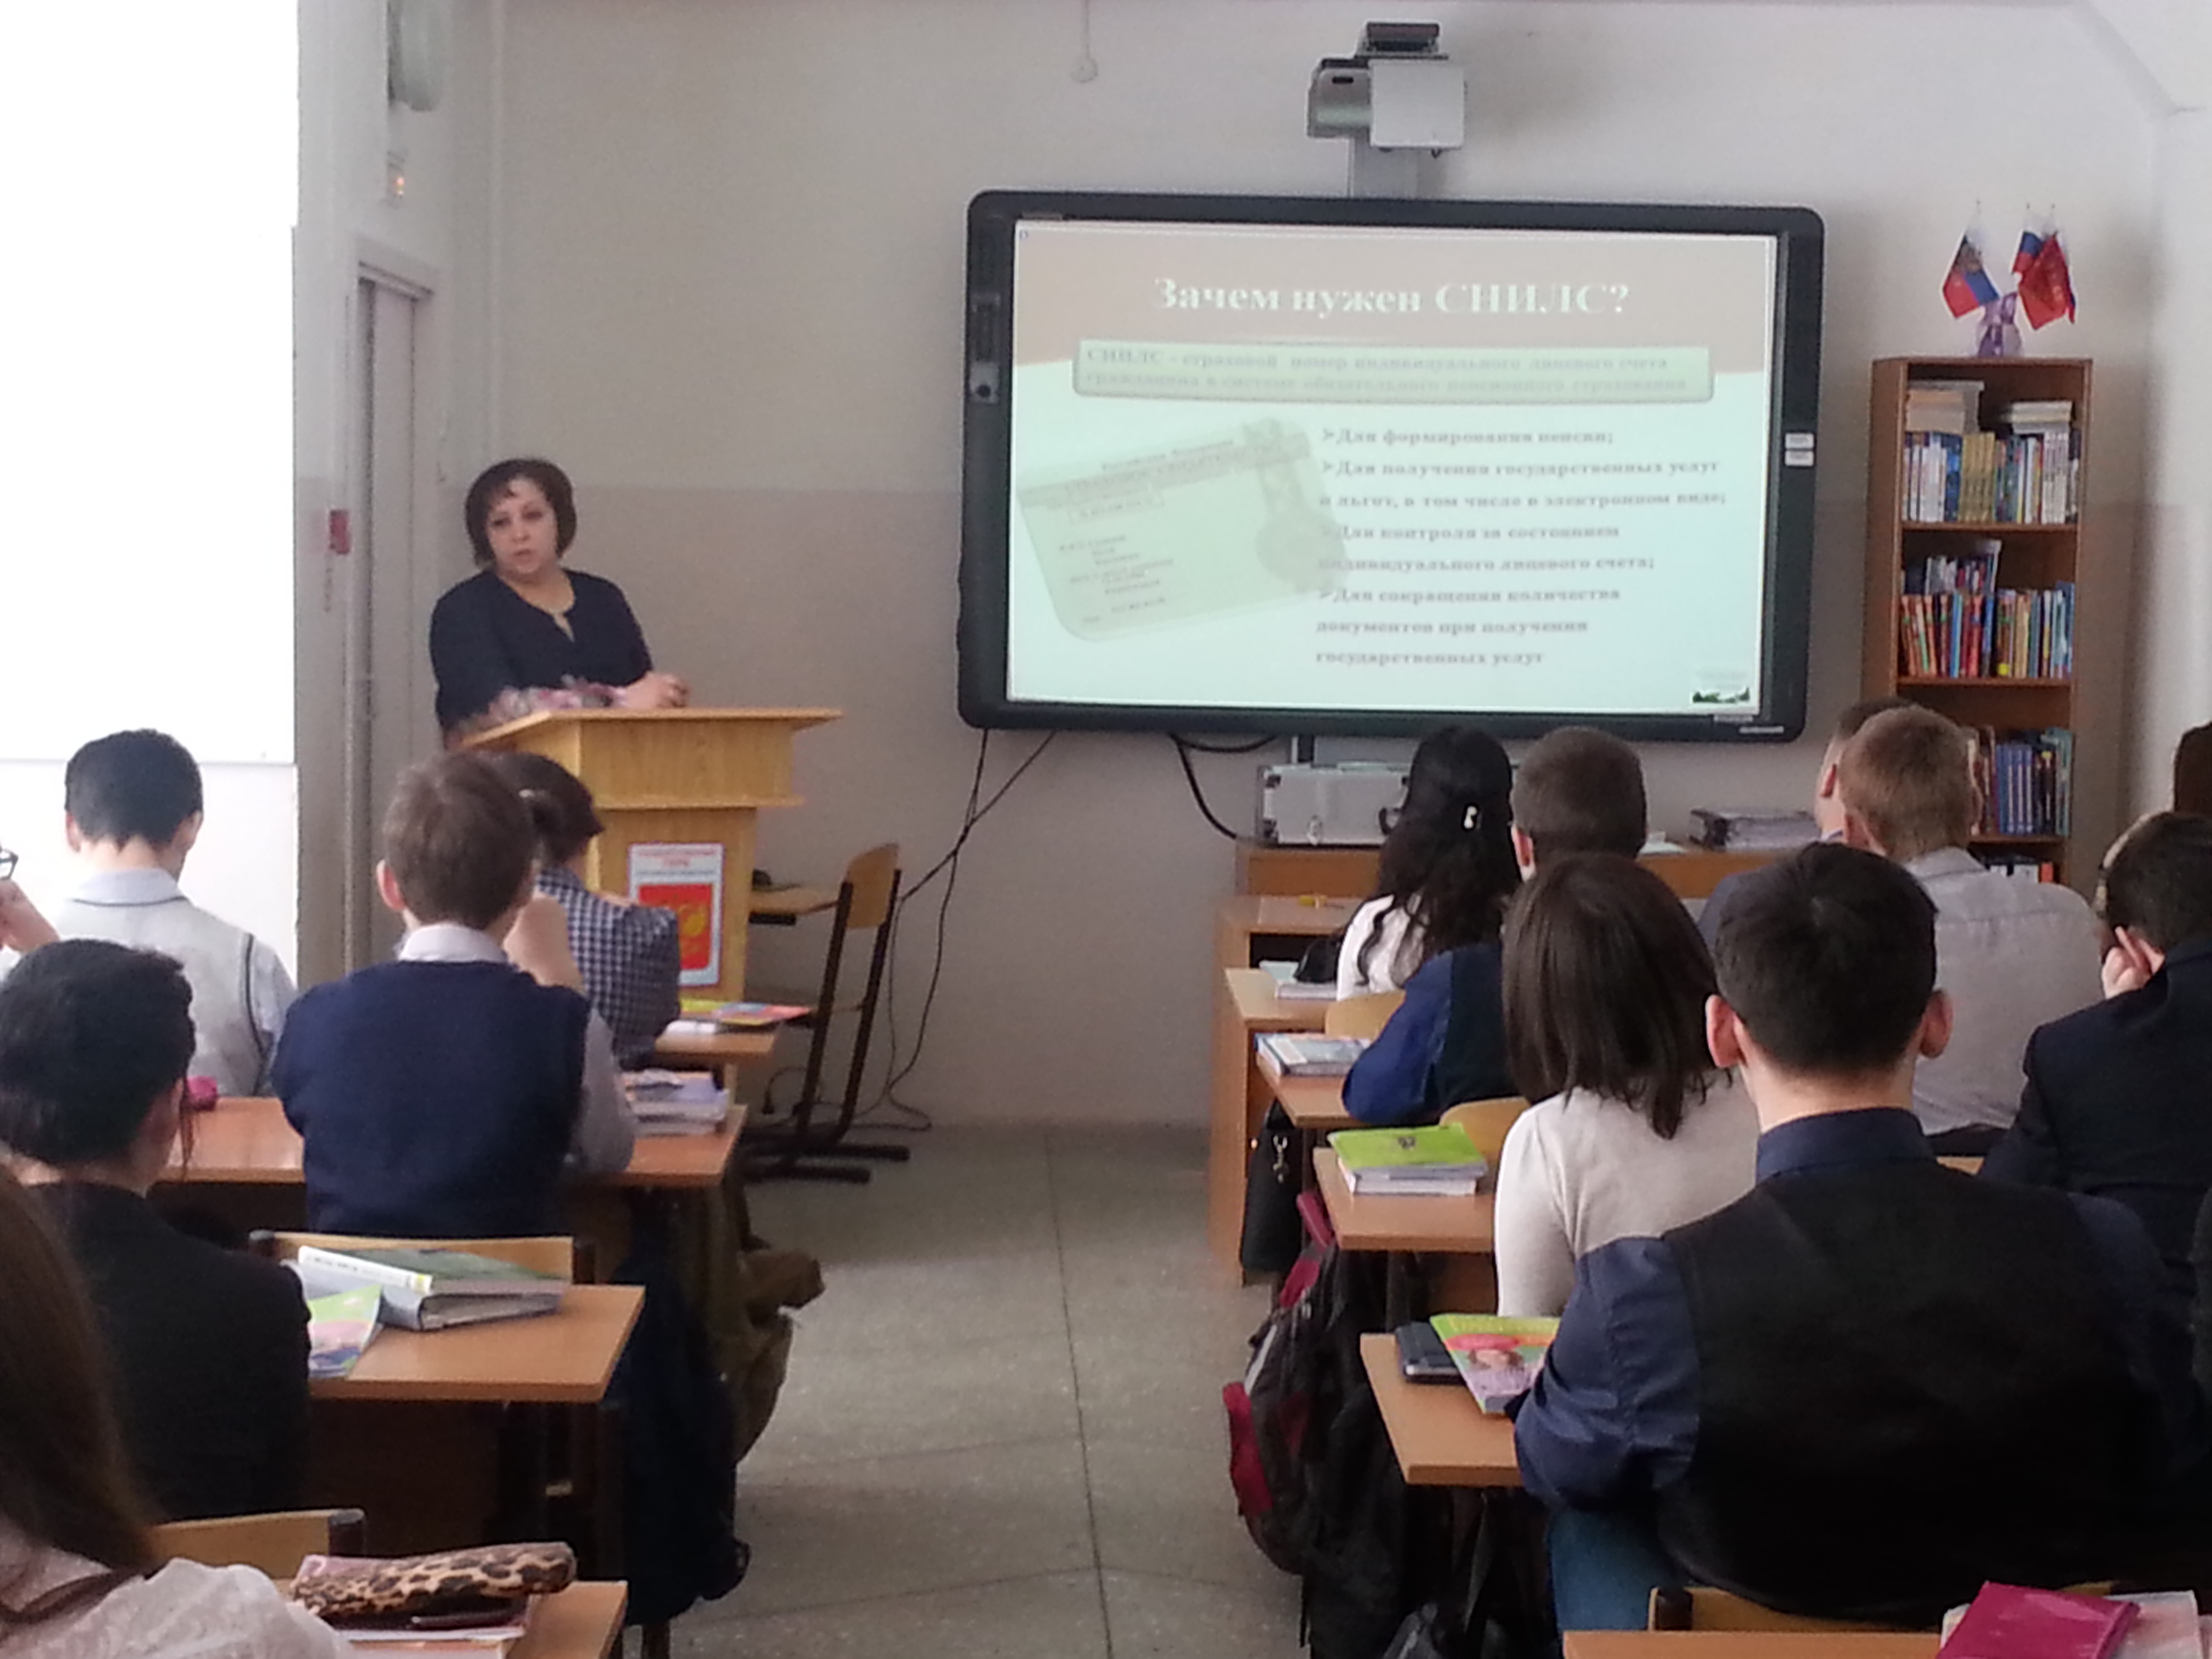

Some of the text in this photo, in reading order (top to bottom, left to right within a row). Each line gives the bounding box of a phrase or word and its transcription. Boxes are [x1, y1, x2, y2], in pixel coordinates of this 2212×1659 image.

[1153, 276, 1631, 319] Зачем нужен СНИЛС?
[1087, 348, 1164, 364] СНИЛС
[1336, 428, 1613, 447] Для формирования пенсии;
[1335, 460, 1721, 479] Для получения государственных услуг
[1338, 497, 1398, 509] льгот,
[1404, 497, 1415, 506] в
[1424, 497, 1458, 506] том
[1464, 496, 1521, 506] числе
[1527, 496, 1538, 506] в
[1544, 494, 1670, 509] электронном
[1677, 492, 1726, 506] виде;
[1336, 525, 1620, 543] Для контроля за состоянием
[1500, 558, 1591, 570] лицевого
[1596, 556, 1654, 570] счета;
[1332, 588, 1620, 606] Для сокращения количества
[1315, 621, 1588, 636] документов при получения
[1315, 652, 1544, 667] государственных услуг
